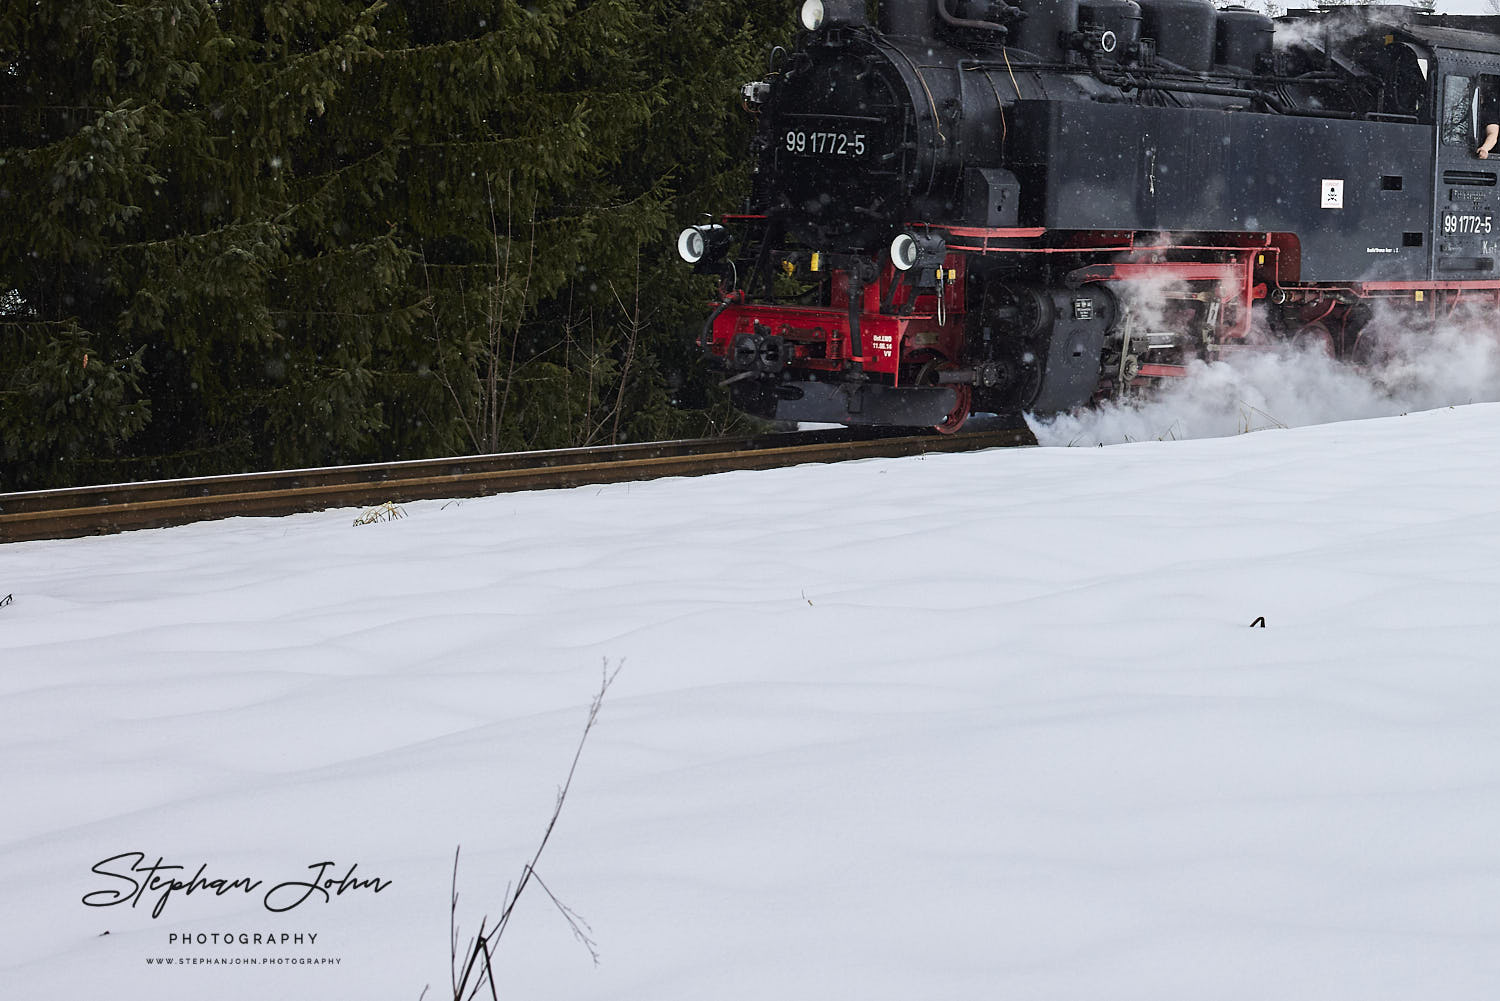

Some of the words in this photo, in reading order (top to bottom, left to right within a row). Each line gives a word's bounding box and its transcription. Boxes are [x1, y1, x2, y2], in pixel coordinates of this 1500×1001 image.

[786, 131, 806, 152] 99
[810, 132, 866, 155] 1772-5
[1444, 214, 1457, 233] 99
[1458, 215, 1492, 234] 1772-5
